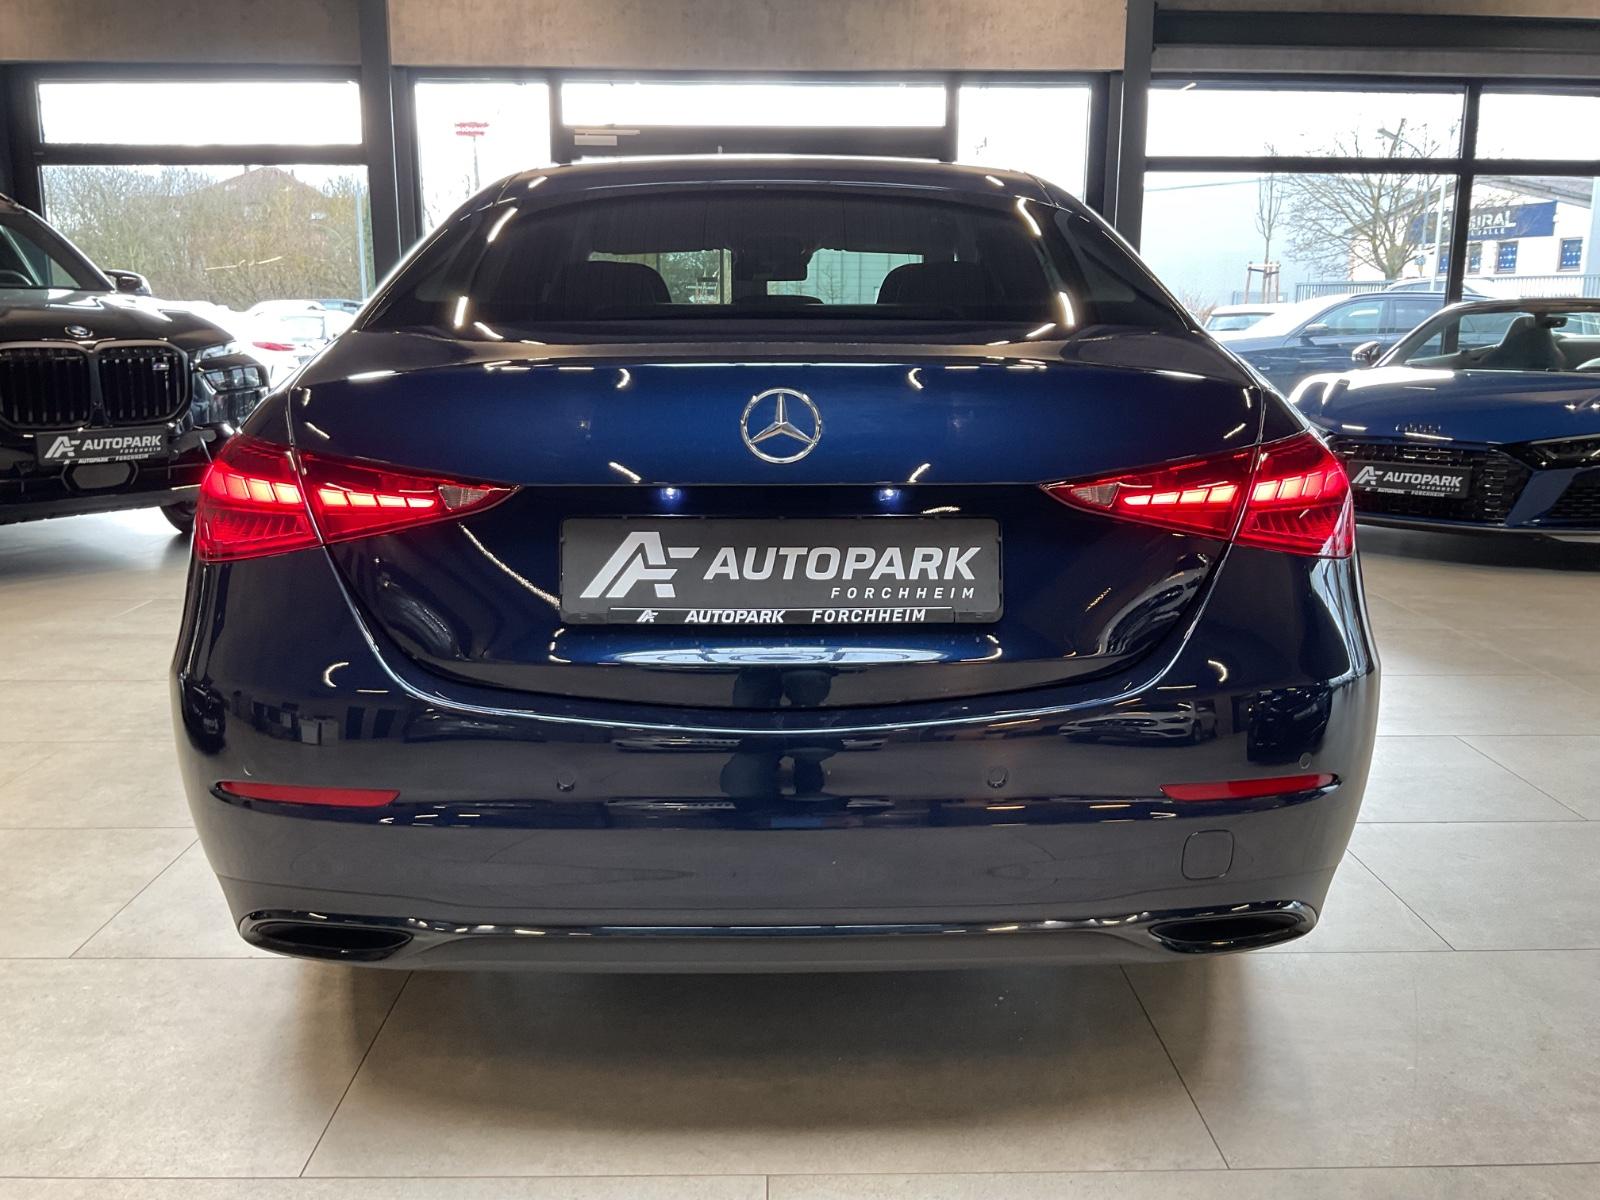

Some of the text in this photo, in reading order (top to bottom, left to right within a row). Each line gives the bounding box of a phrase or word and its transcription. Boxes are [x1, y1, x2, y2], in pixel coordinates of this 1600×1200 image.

[82, 435, 162, 451] AUTOPARK
[1383, 471, 1464, 487] AUTOPARK
[703, 547, 981, 580] AUTOPARK
[831, 587, 975, 599] FORCHHEIM
[685, 609, 786, 623] AUTOPARK
[811, 609, 926, 623] FORCHHEIM
